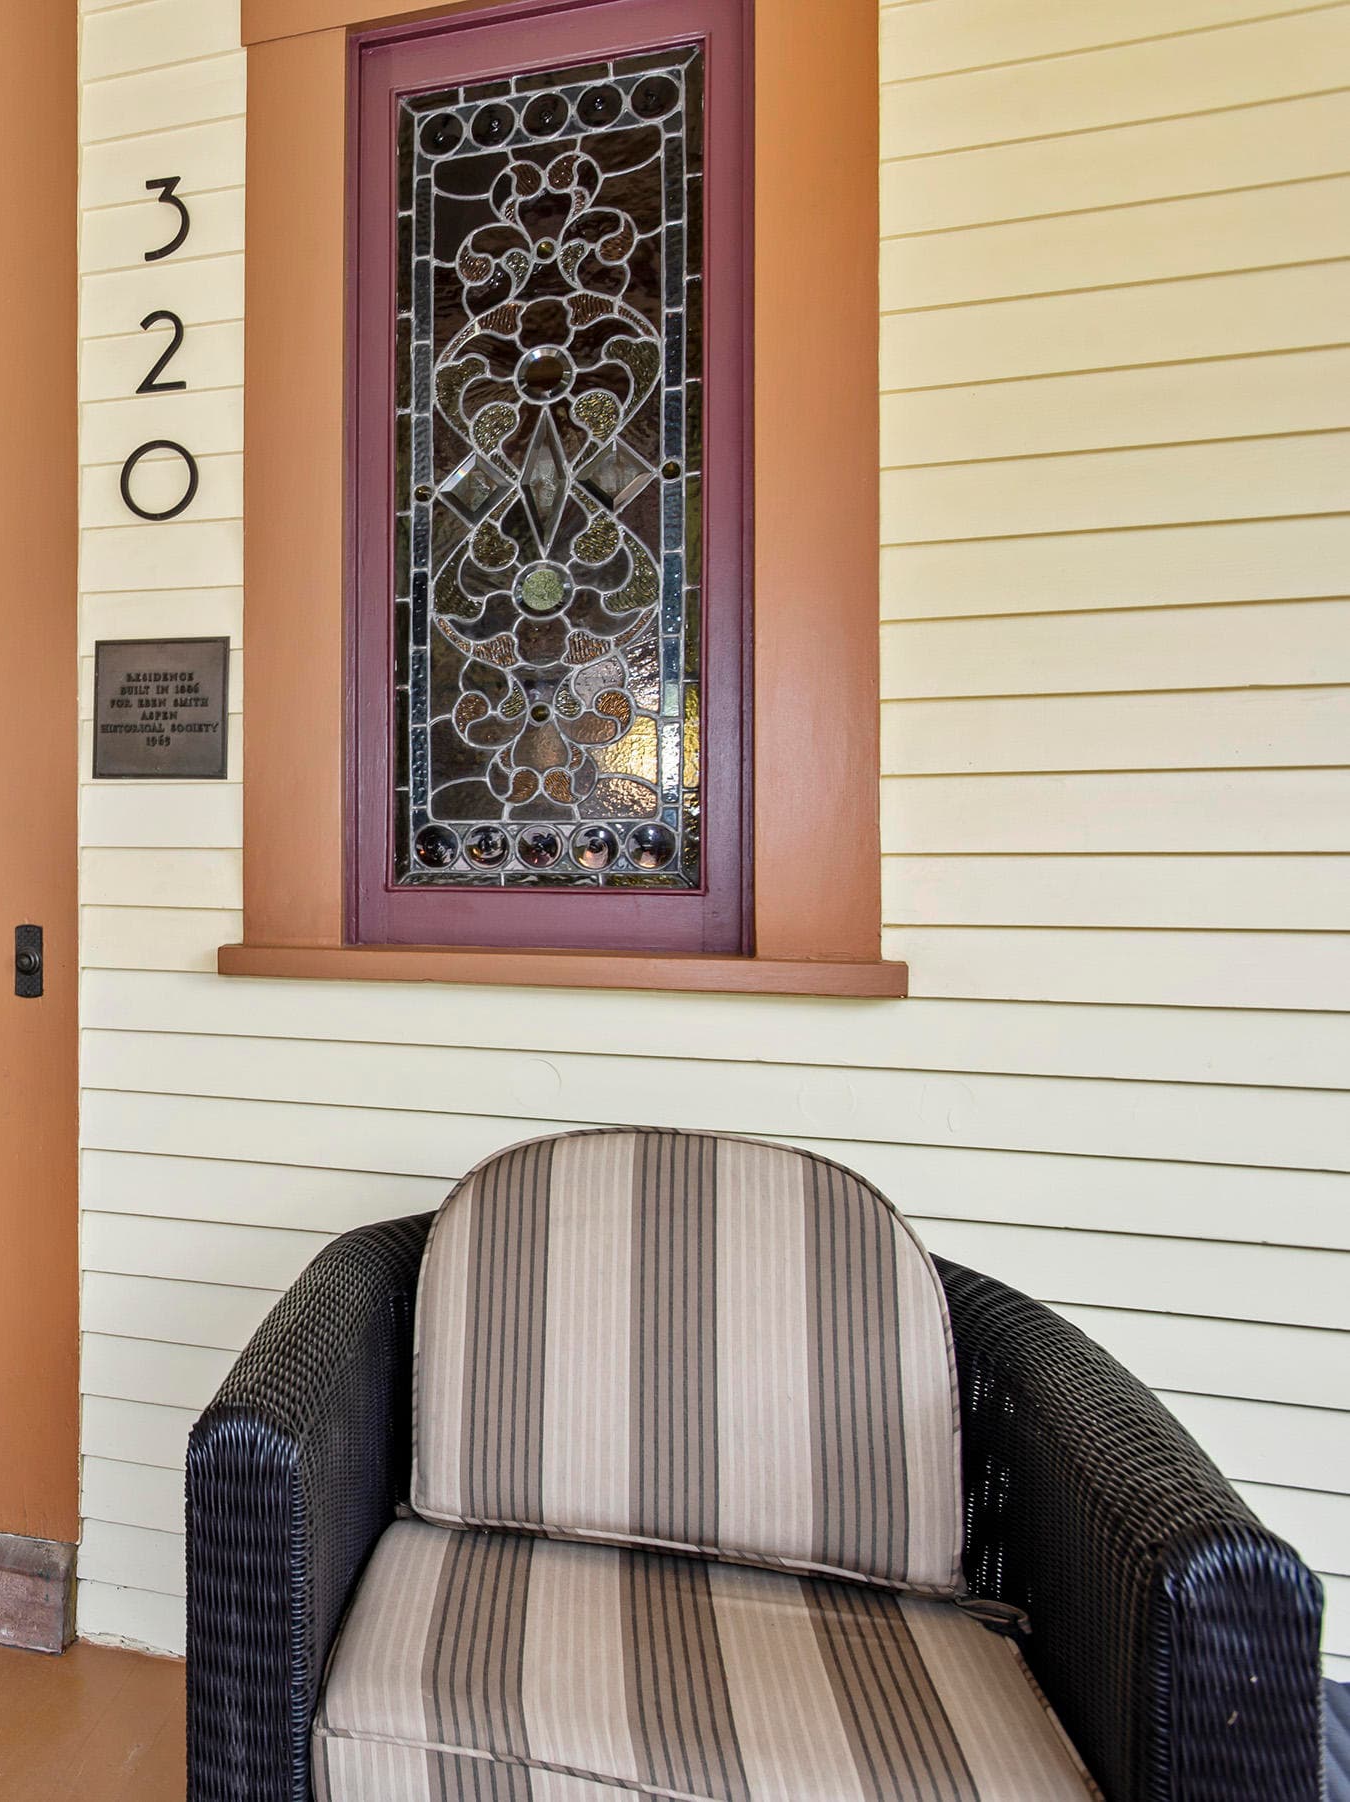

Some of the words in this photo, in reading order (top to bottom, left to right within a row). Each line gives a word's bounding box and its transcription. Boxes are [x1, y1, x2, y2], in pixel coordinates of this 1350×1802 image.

[126, 671, 194, 683] RESIDENCE
[120, 684, 150, 696] BUILT
[156, 685, 169, 695] IN
[110, 699, 133, 709] FOR
[137, 698, 167, 709] EBEN
[173, 697, 209, 708] SMITH
[140, 710, 178, 721] ASPEN
[100, 722, 165, 734] HISTORICAL
[170, 722, 219, 733] SOCIETY
